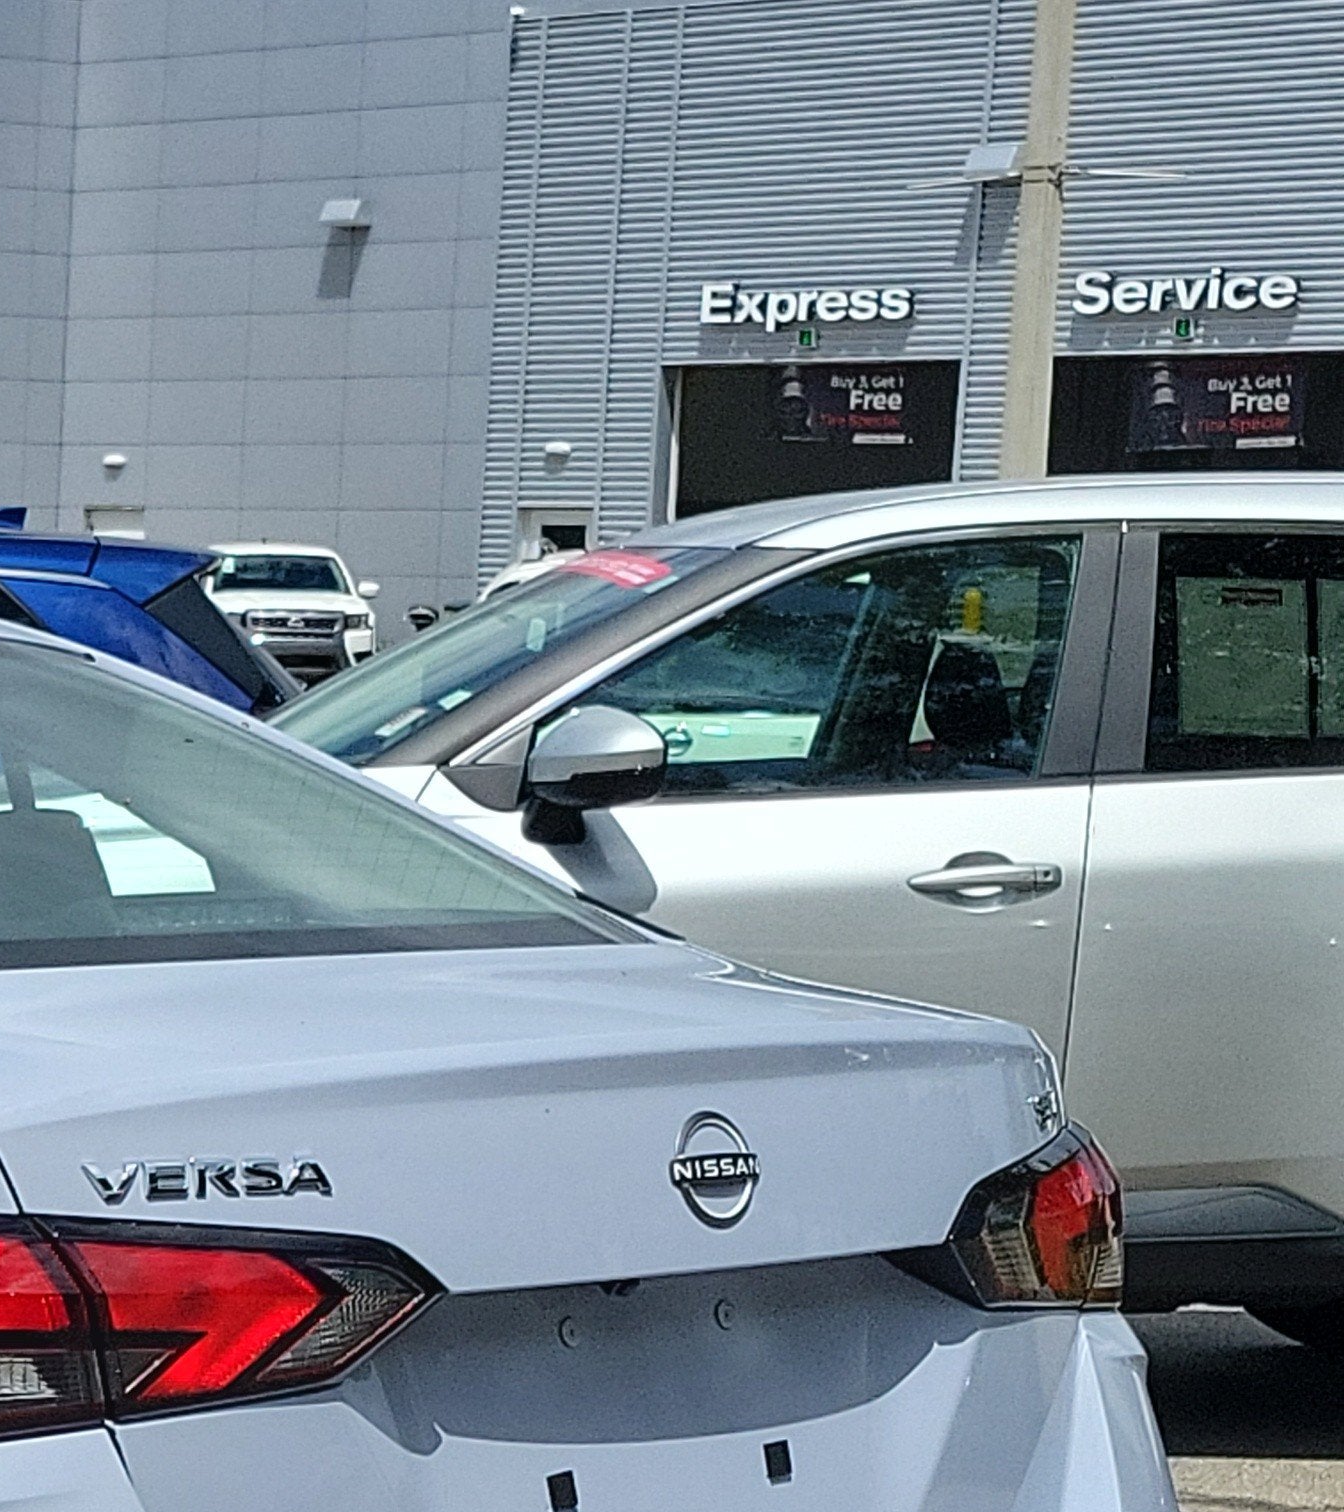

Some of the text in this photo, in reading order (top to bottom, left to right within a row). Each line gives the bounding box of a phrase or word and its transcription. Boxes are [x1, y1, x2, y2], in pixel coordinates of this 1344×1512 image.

[699, 267, 1299, 332] Express Service
[830, 376, 857, 390] Buy
[871, 375, 896, 389] Get
[1207, 378, 1237, 393] Buy
[1255, 375, 1281, 390] Get
[849, 390, 902, 411] Free
[1230, 392, 1291, 414] Free
[673, 1157, 760, 1181] NISSAN
[80, 1156, 333, 1205] VERSA
